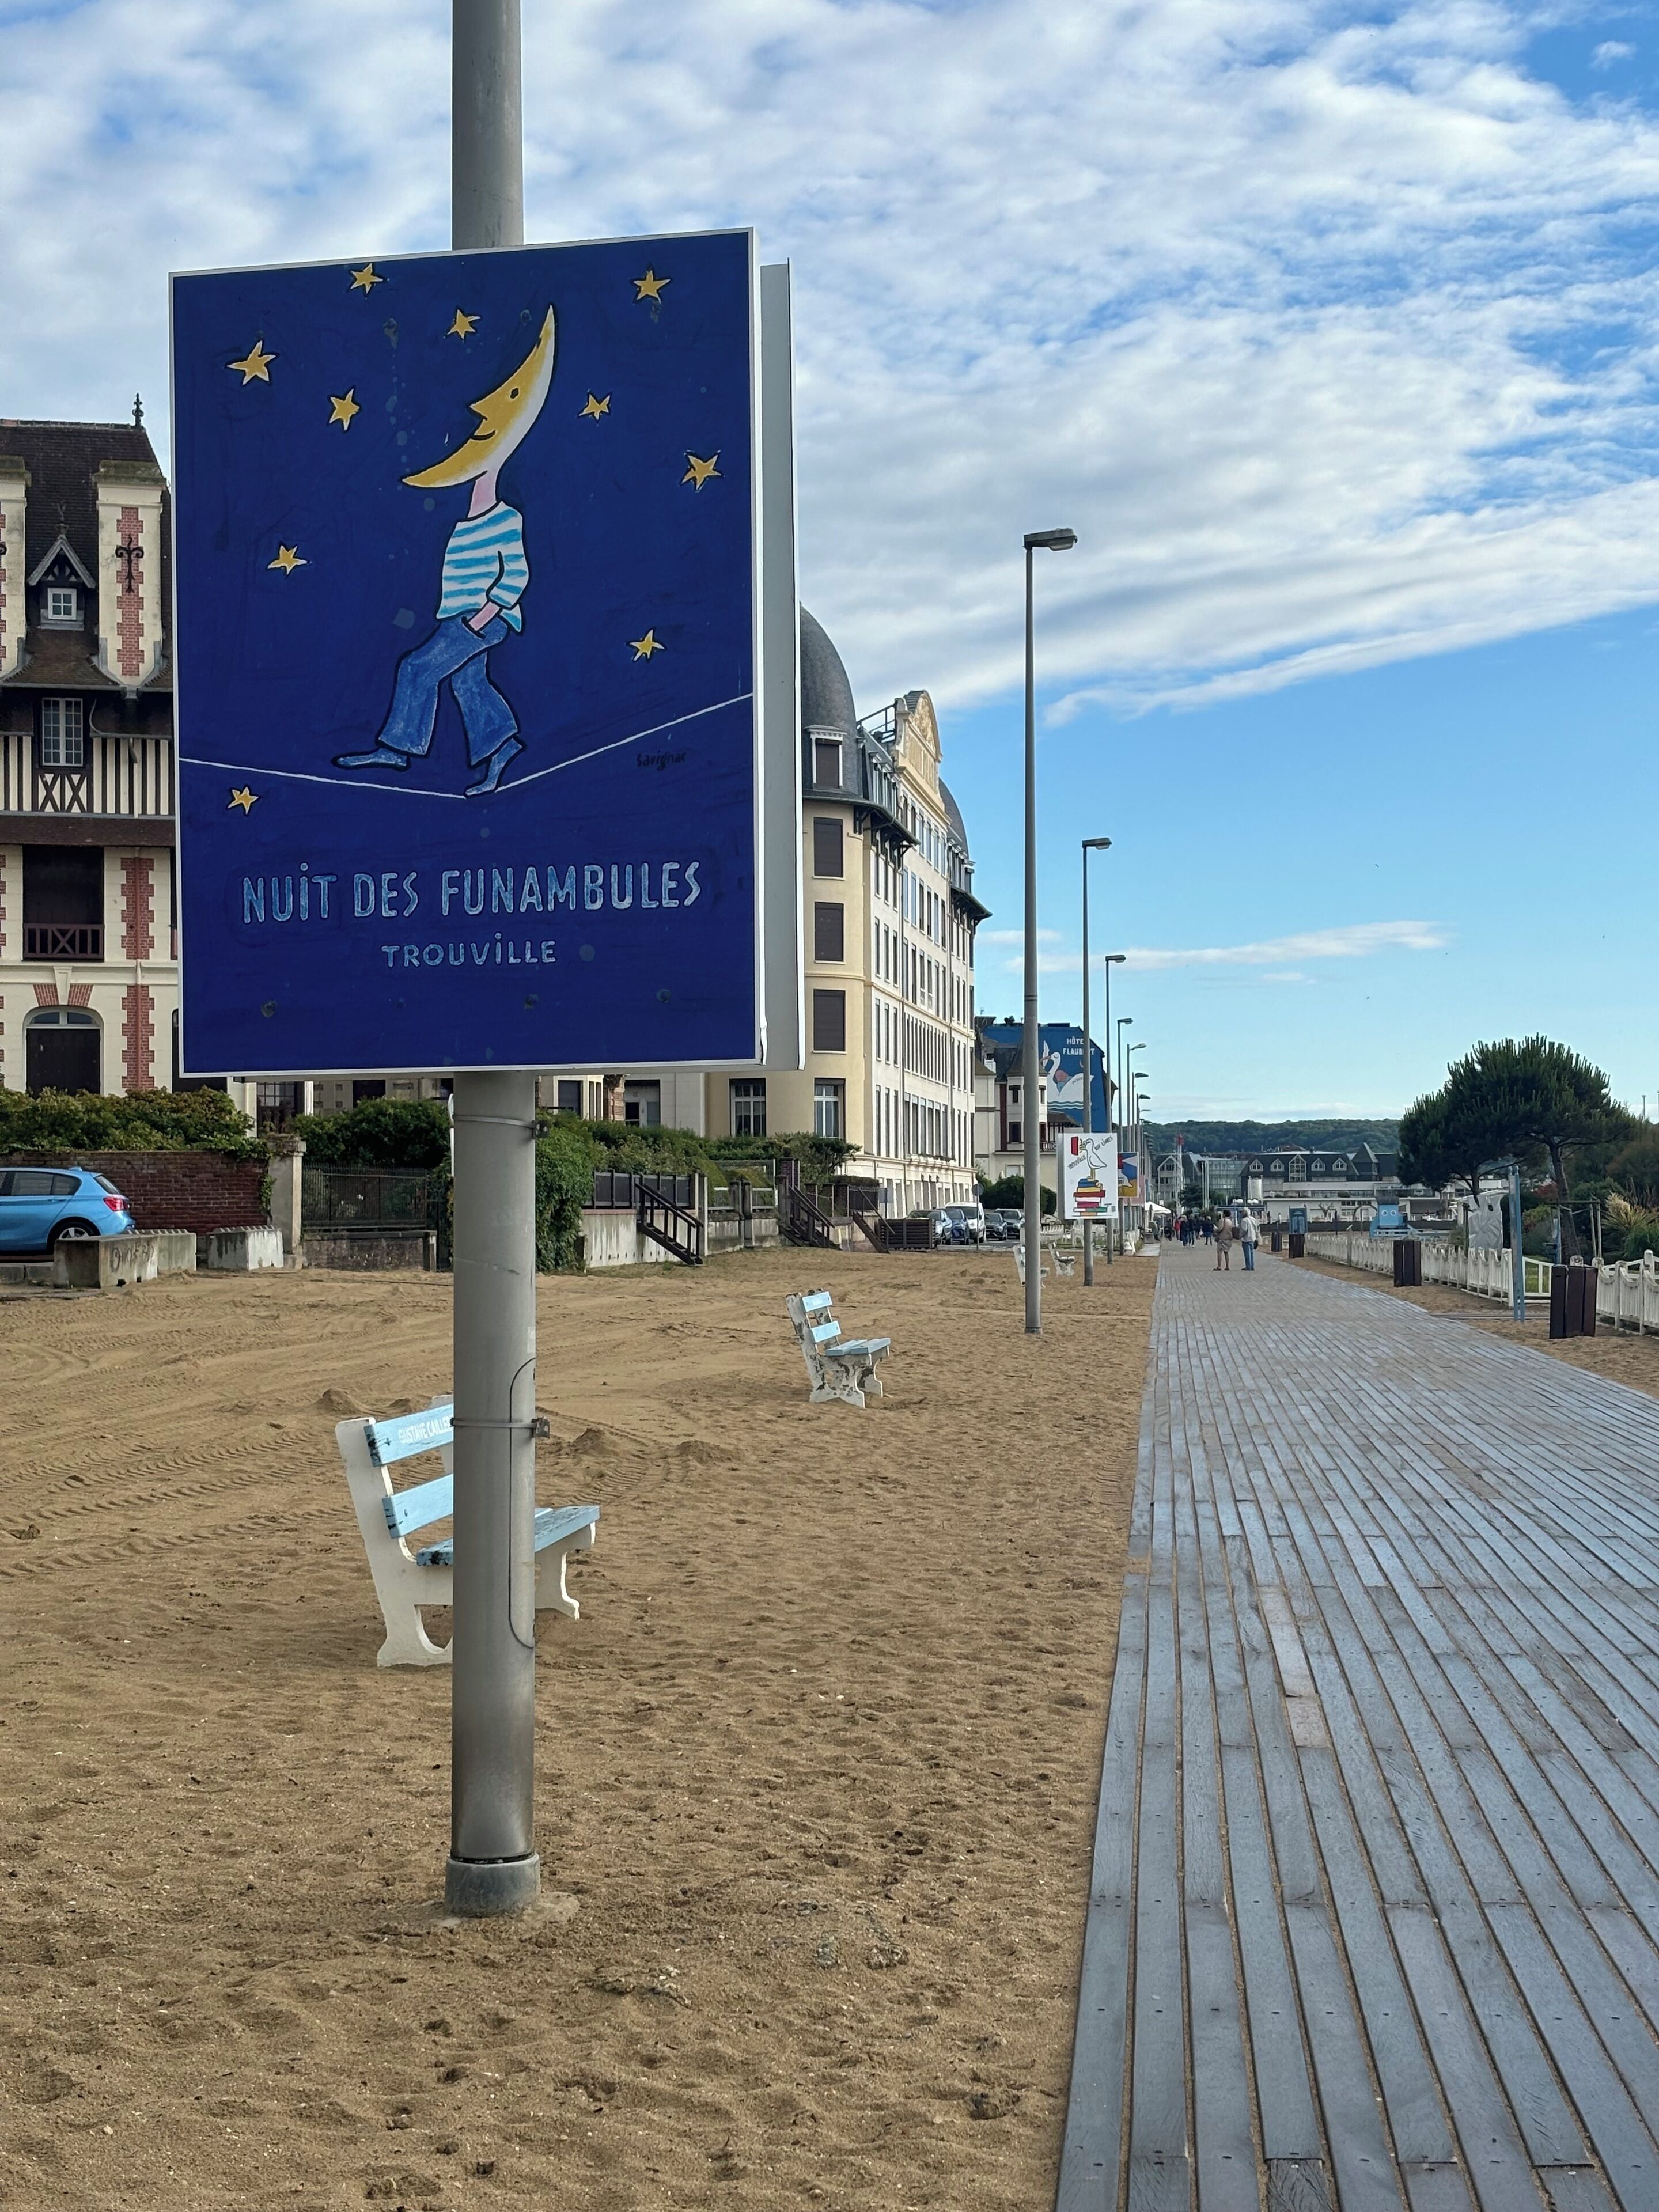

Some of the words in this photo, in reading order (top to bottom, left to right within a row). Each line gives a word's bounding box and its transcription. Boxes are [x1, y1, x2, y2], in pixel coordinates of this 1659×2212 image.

[353, 871, 418, 918] DES
[441, 861, 702, 917] FUNAMBULES
[1066, 1036, 1084, 1045] HÔTE
[1062, 1048, 1095, 1056] FLAUBT
